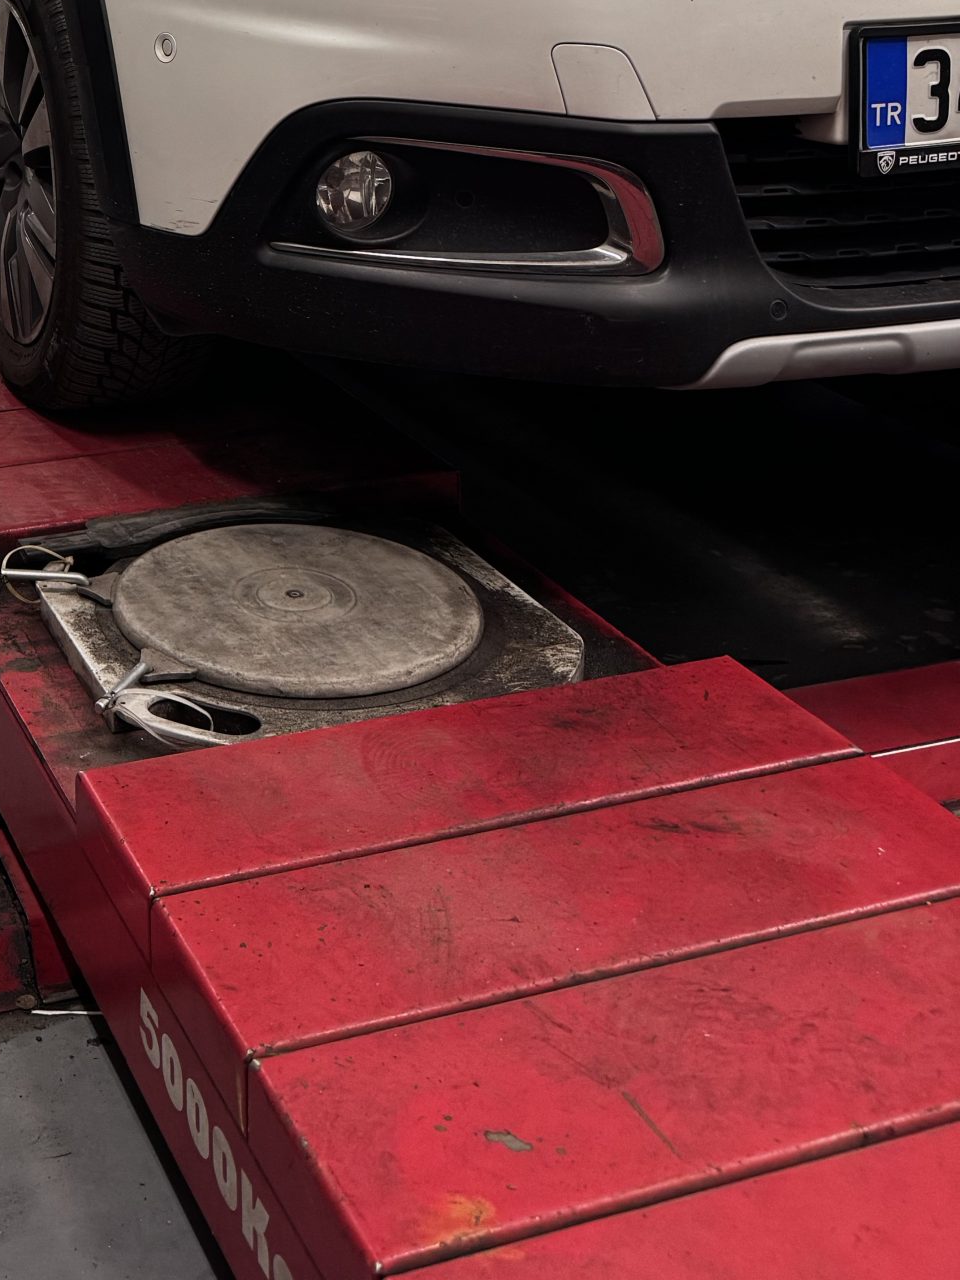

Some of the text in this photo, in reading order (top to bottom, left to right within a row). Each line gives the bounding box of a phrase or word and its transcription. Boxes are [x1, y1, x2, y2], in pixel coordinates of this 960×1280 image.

[912, 48, 960, 133] 3
[871, 102, 902, 127] TR
[899, 151, 960, 166] PEUGEO
